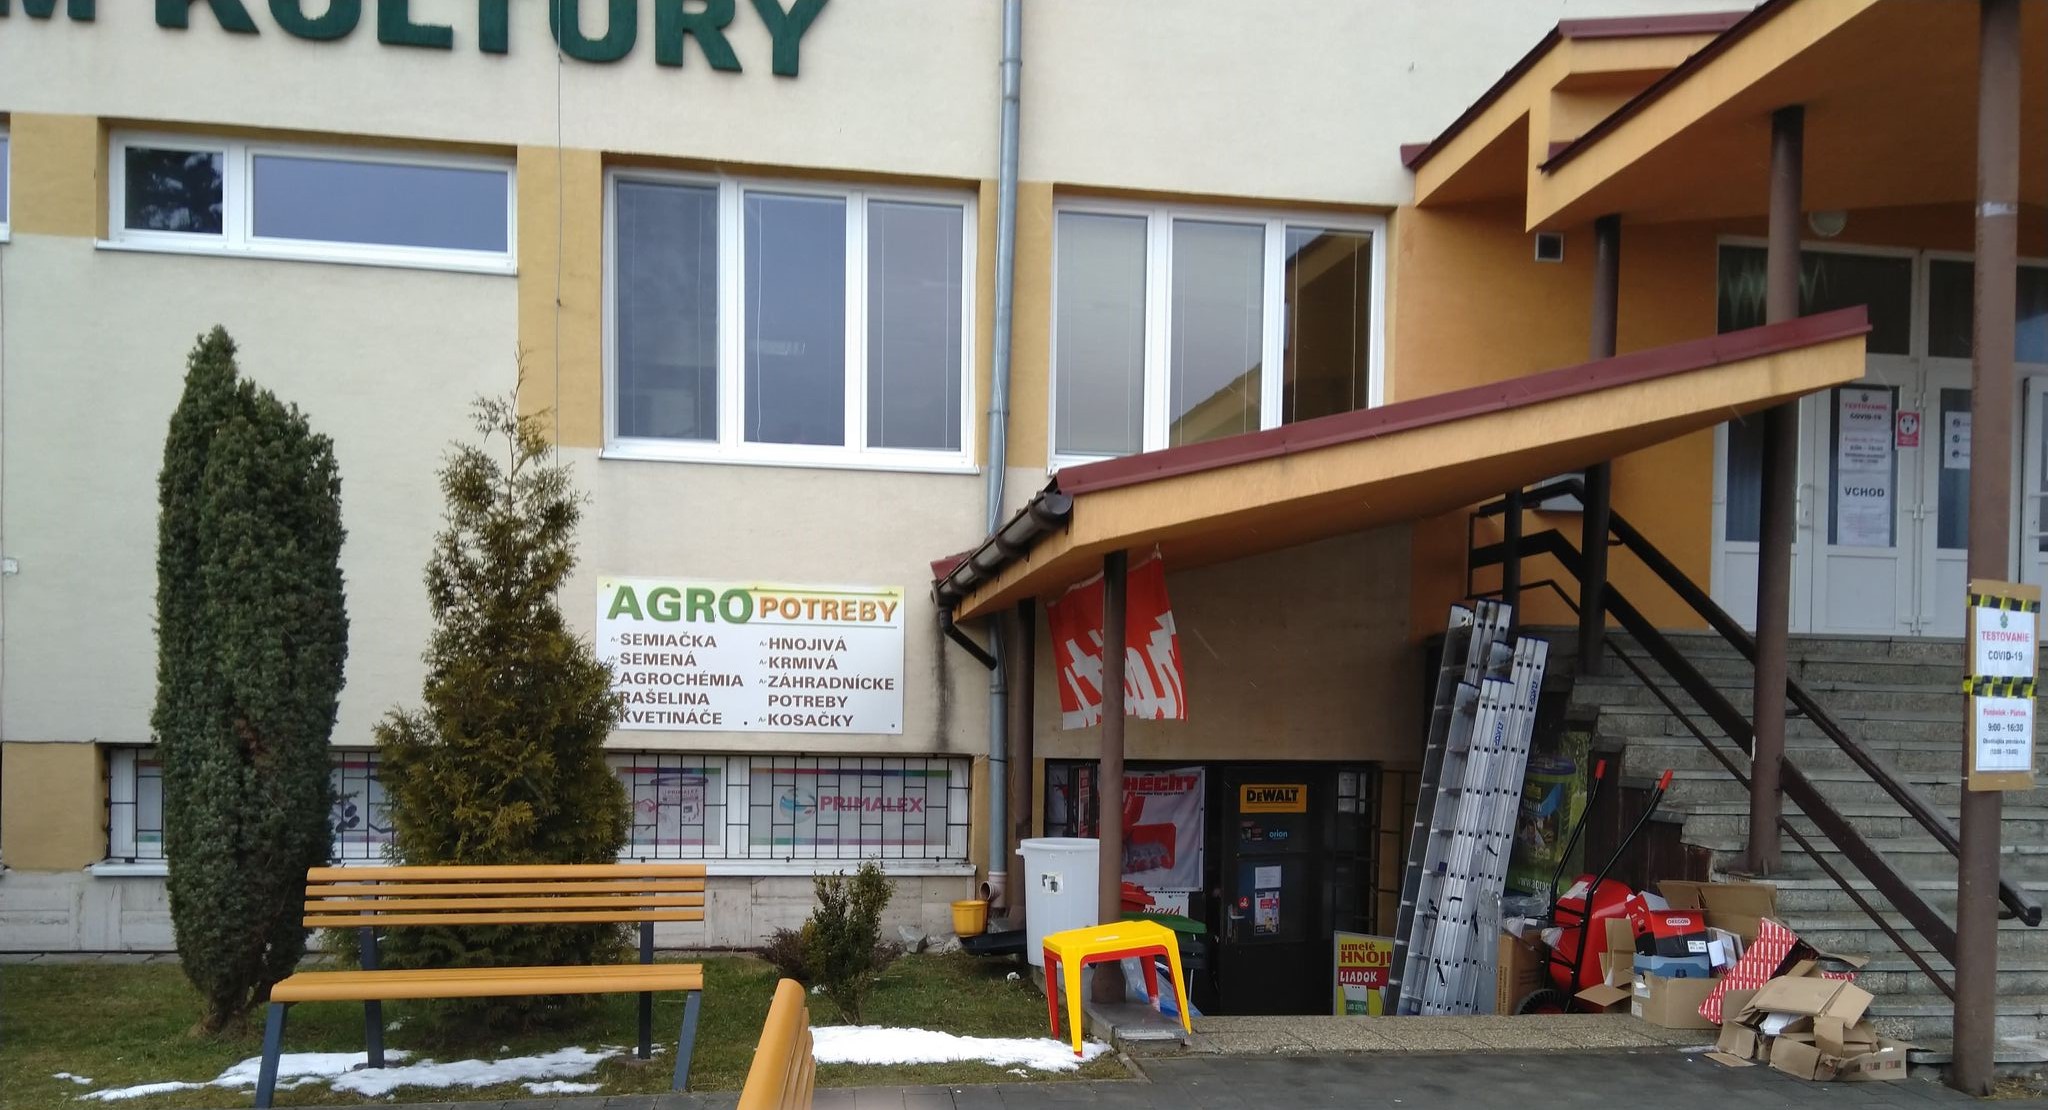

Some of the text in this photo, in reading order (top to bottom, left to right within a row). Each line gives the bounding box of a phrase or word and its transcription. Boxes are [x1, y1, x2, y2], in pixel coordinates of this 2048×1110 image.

[1844, 486, 1885, 497] VCHOD
[607, 586, 898, 624] AGRO POTREBY
[620, 631, 717, 648] SEMIAČKA
[768, 635, 848, 652] HNOJIVÁ
[1981, 631, 2030, 642] TESTOVANIE
[620, 651, 697, 667] SEMENÁ
[768, 654, 838, 671] KRMIVÁ
[1988, 650, 2023, 661] COVID-19
[620, 670, 744, 688] AGROCHÉMIA
[768, 673, 895, 691] ZÁHRADNÍCKE
[768, 694, 849, 709] POTREBY
[620, 709, 723, 726] KVETINÁČE
[768, 710, 854, 728] KOSAČKY
[1988, 722, 2001, 732] 9:00
[820, 795, 924, 814] PRIMALEX
[1341, 941, 1376, 951] umelé
[1341, 952, 1391, 966] HNOJI
[1340, 972, 1377, 982] LIADOK
